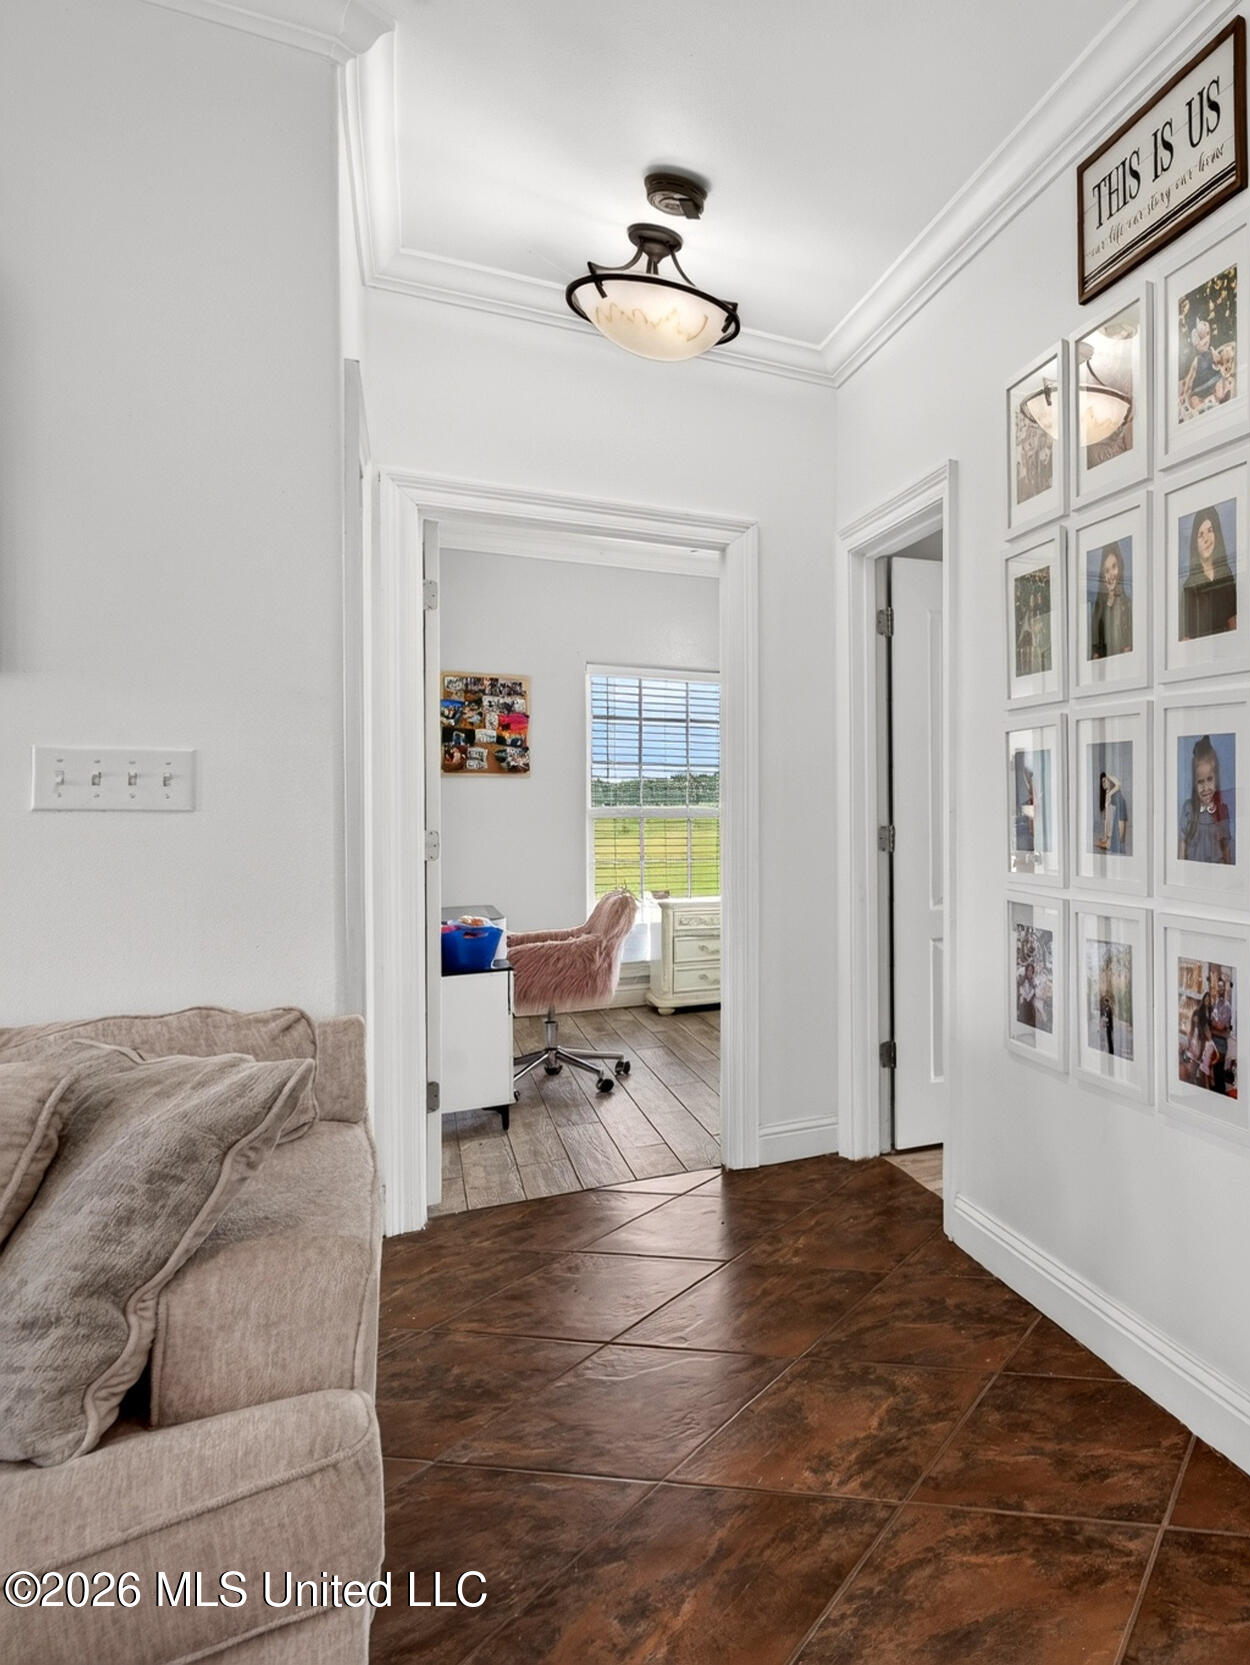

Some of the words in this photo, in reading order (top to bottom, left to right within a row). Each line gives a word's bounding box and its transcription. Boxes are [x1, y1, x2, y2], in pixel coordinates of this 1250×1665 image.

[1092, 147, 1141, 230] THIS
[1151, 118, 1175, 184] IS
[1185, 76, 1221, 149] US
[1109, 222, 1125, 246] life
[1147, 186, 1172, 215] story
[1175, 170, 1194, 190] our
